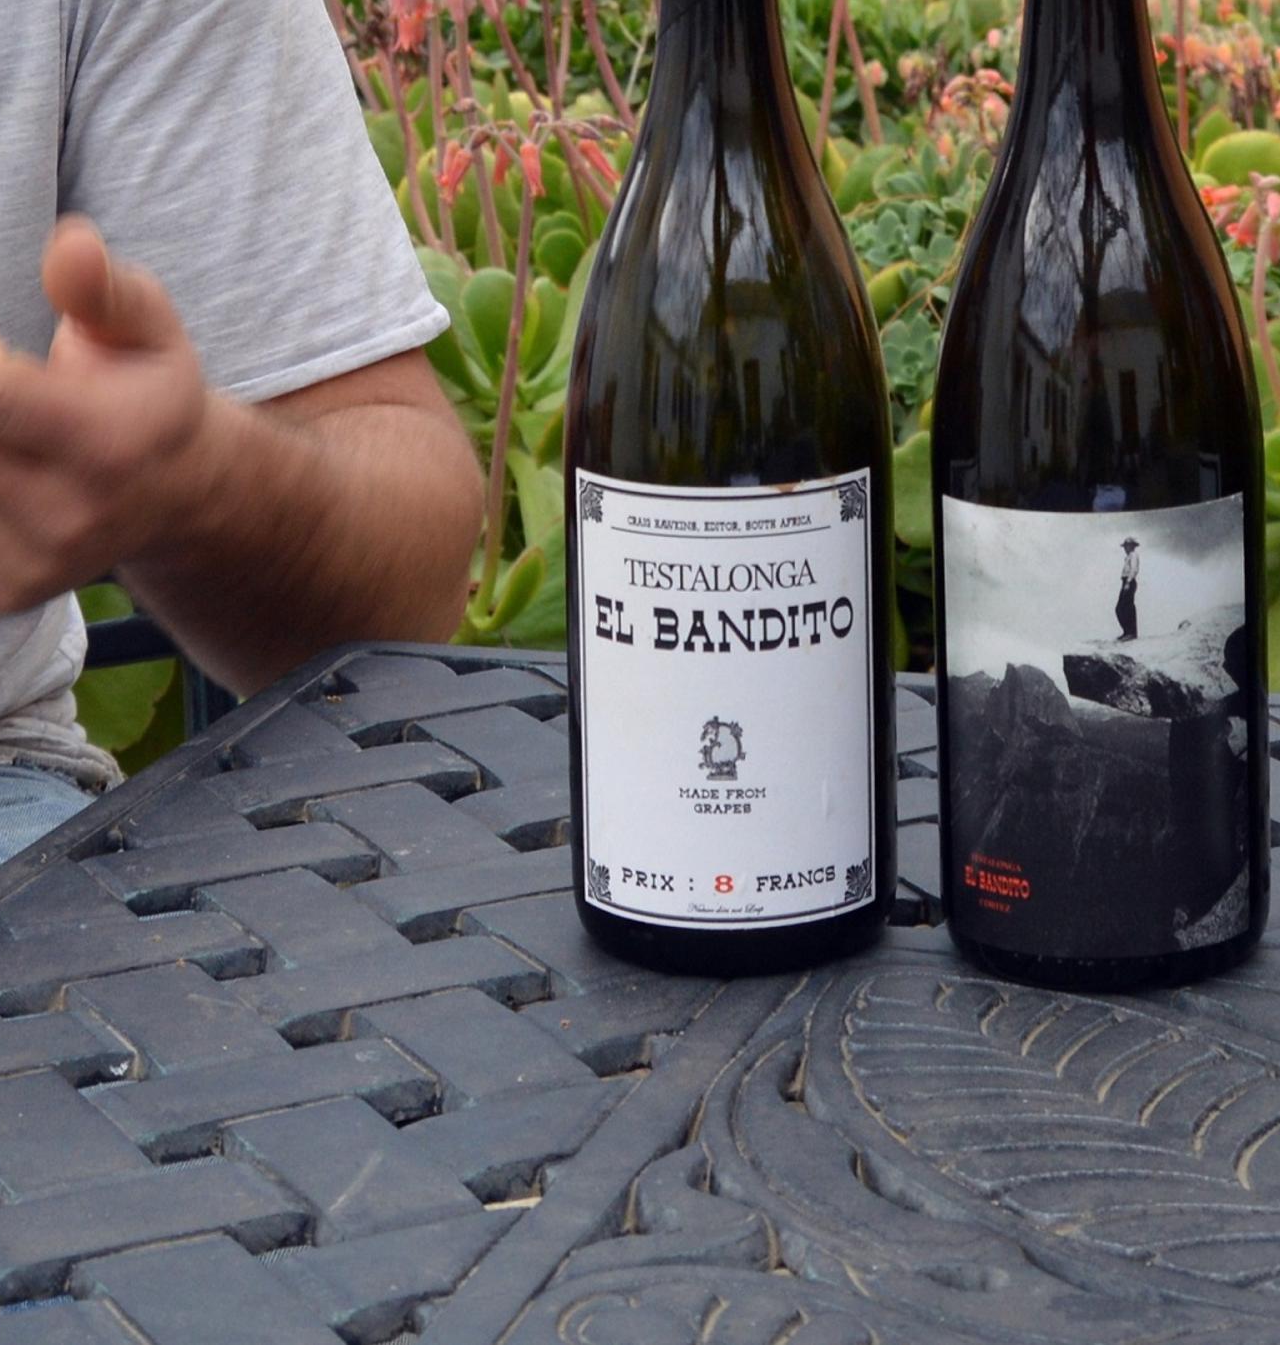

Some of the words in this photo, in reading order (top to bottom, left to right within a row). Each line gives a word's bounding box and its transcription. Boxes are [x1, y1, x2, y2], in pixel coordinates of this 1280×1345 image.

[745, 518, 777, 531] SOUTH
[780, 514, 812, 528] AFRICA
[624, 557, 817, 593] TESTALONGA
[595, 594, 634, 645] EL
[652, 596, 854, 653] BANDITO
[679, 787, 720, 800] MADE
[725, 786, 767, 800] FROM
[693, 803, 752, 815] GRAPES
[621, 866, 675, 893] PRIX
[713, 874, 735, 894] 8
[755, 865, 837, 893] FRANCS
[965, 865, 977, 886] EL
[979, 871, 1030, 898] BANDITO
